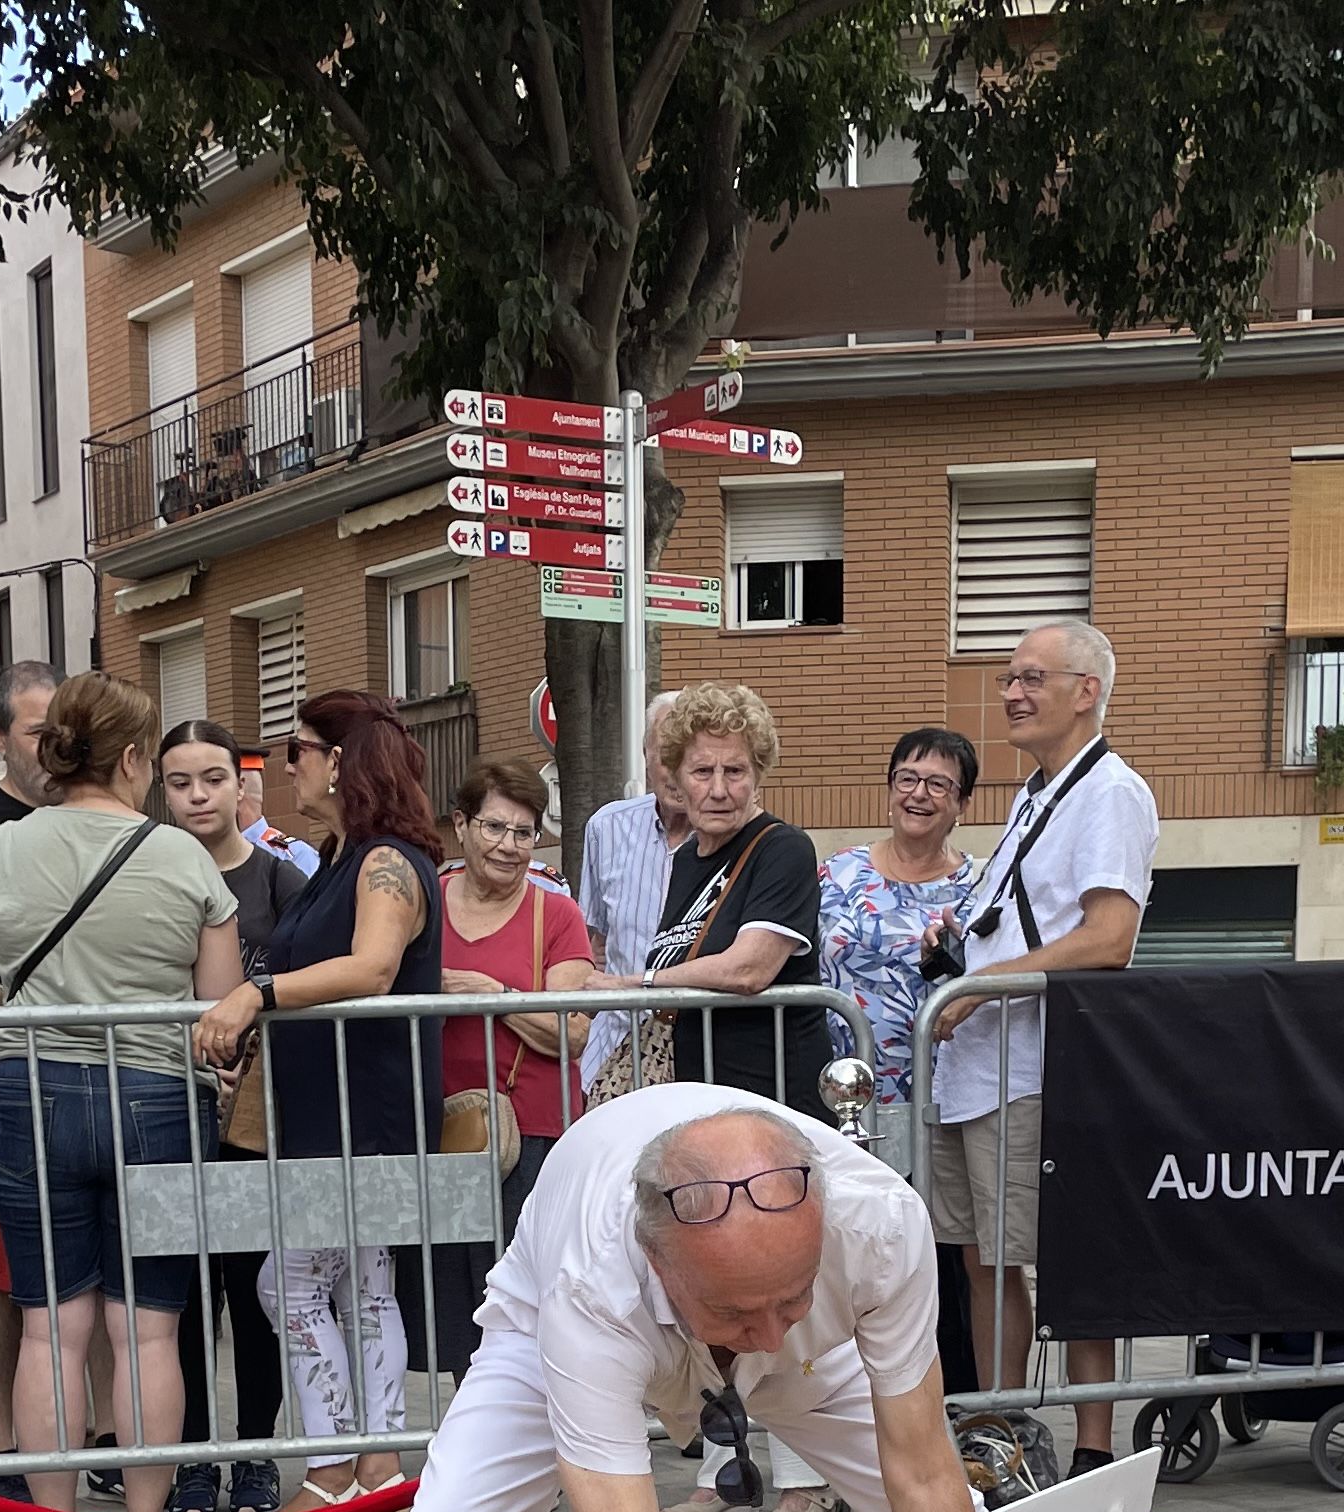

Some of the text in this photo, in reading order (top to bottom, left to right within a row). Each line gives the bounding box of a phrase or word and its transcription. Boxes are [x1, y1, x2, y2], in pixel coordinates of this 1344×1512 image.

[552, 411, 601, 428] Ajuntament
[687, 427, 728, 444] Municipal
[752, 434, 766, 453] P
[527, 445, 557, 460] Museu
[557, 449, 601, 466] Etnogràfic
[559, 464, 601, 479] Vallhonrat
[513, 486, 550, 502] Església
[550, 490, 562, 502] de
[562, 491, 583, 505] Sant
[583, 496, 602, 508] Pere
[558, 505, 569, 516] Dr.
[490, 531, 505, 550] P
[572, 541, 602, 557] Jutjats
